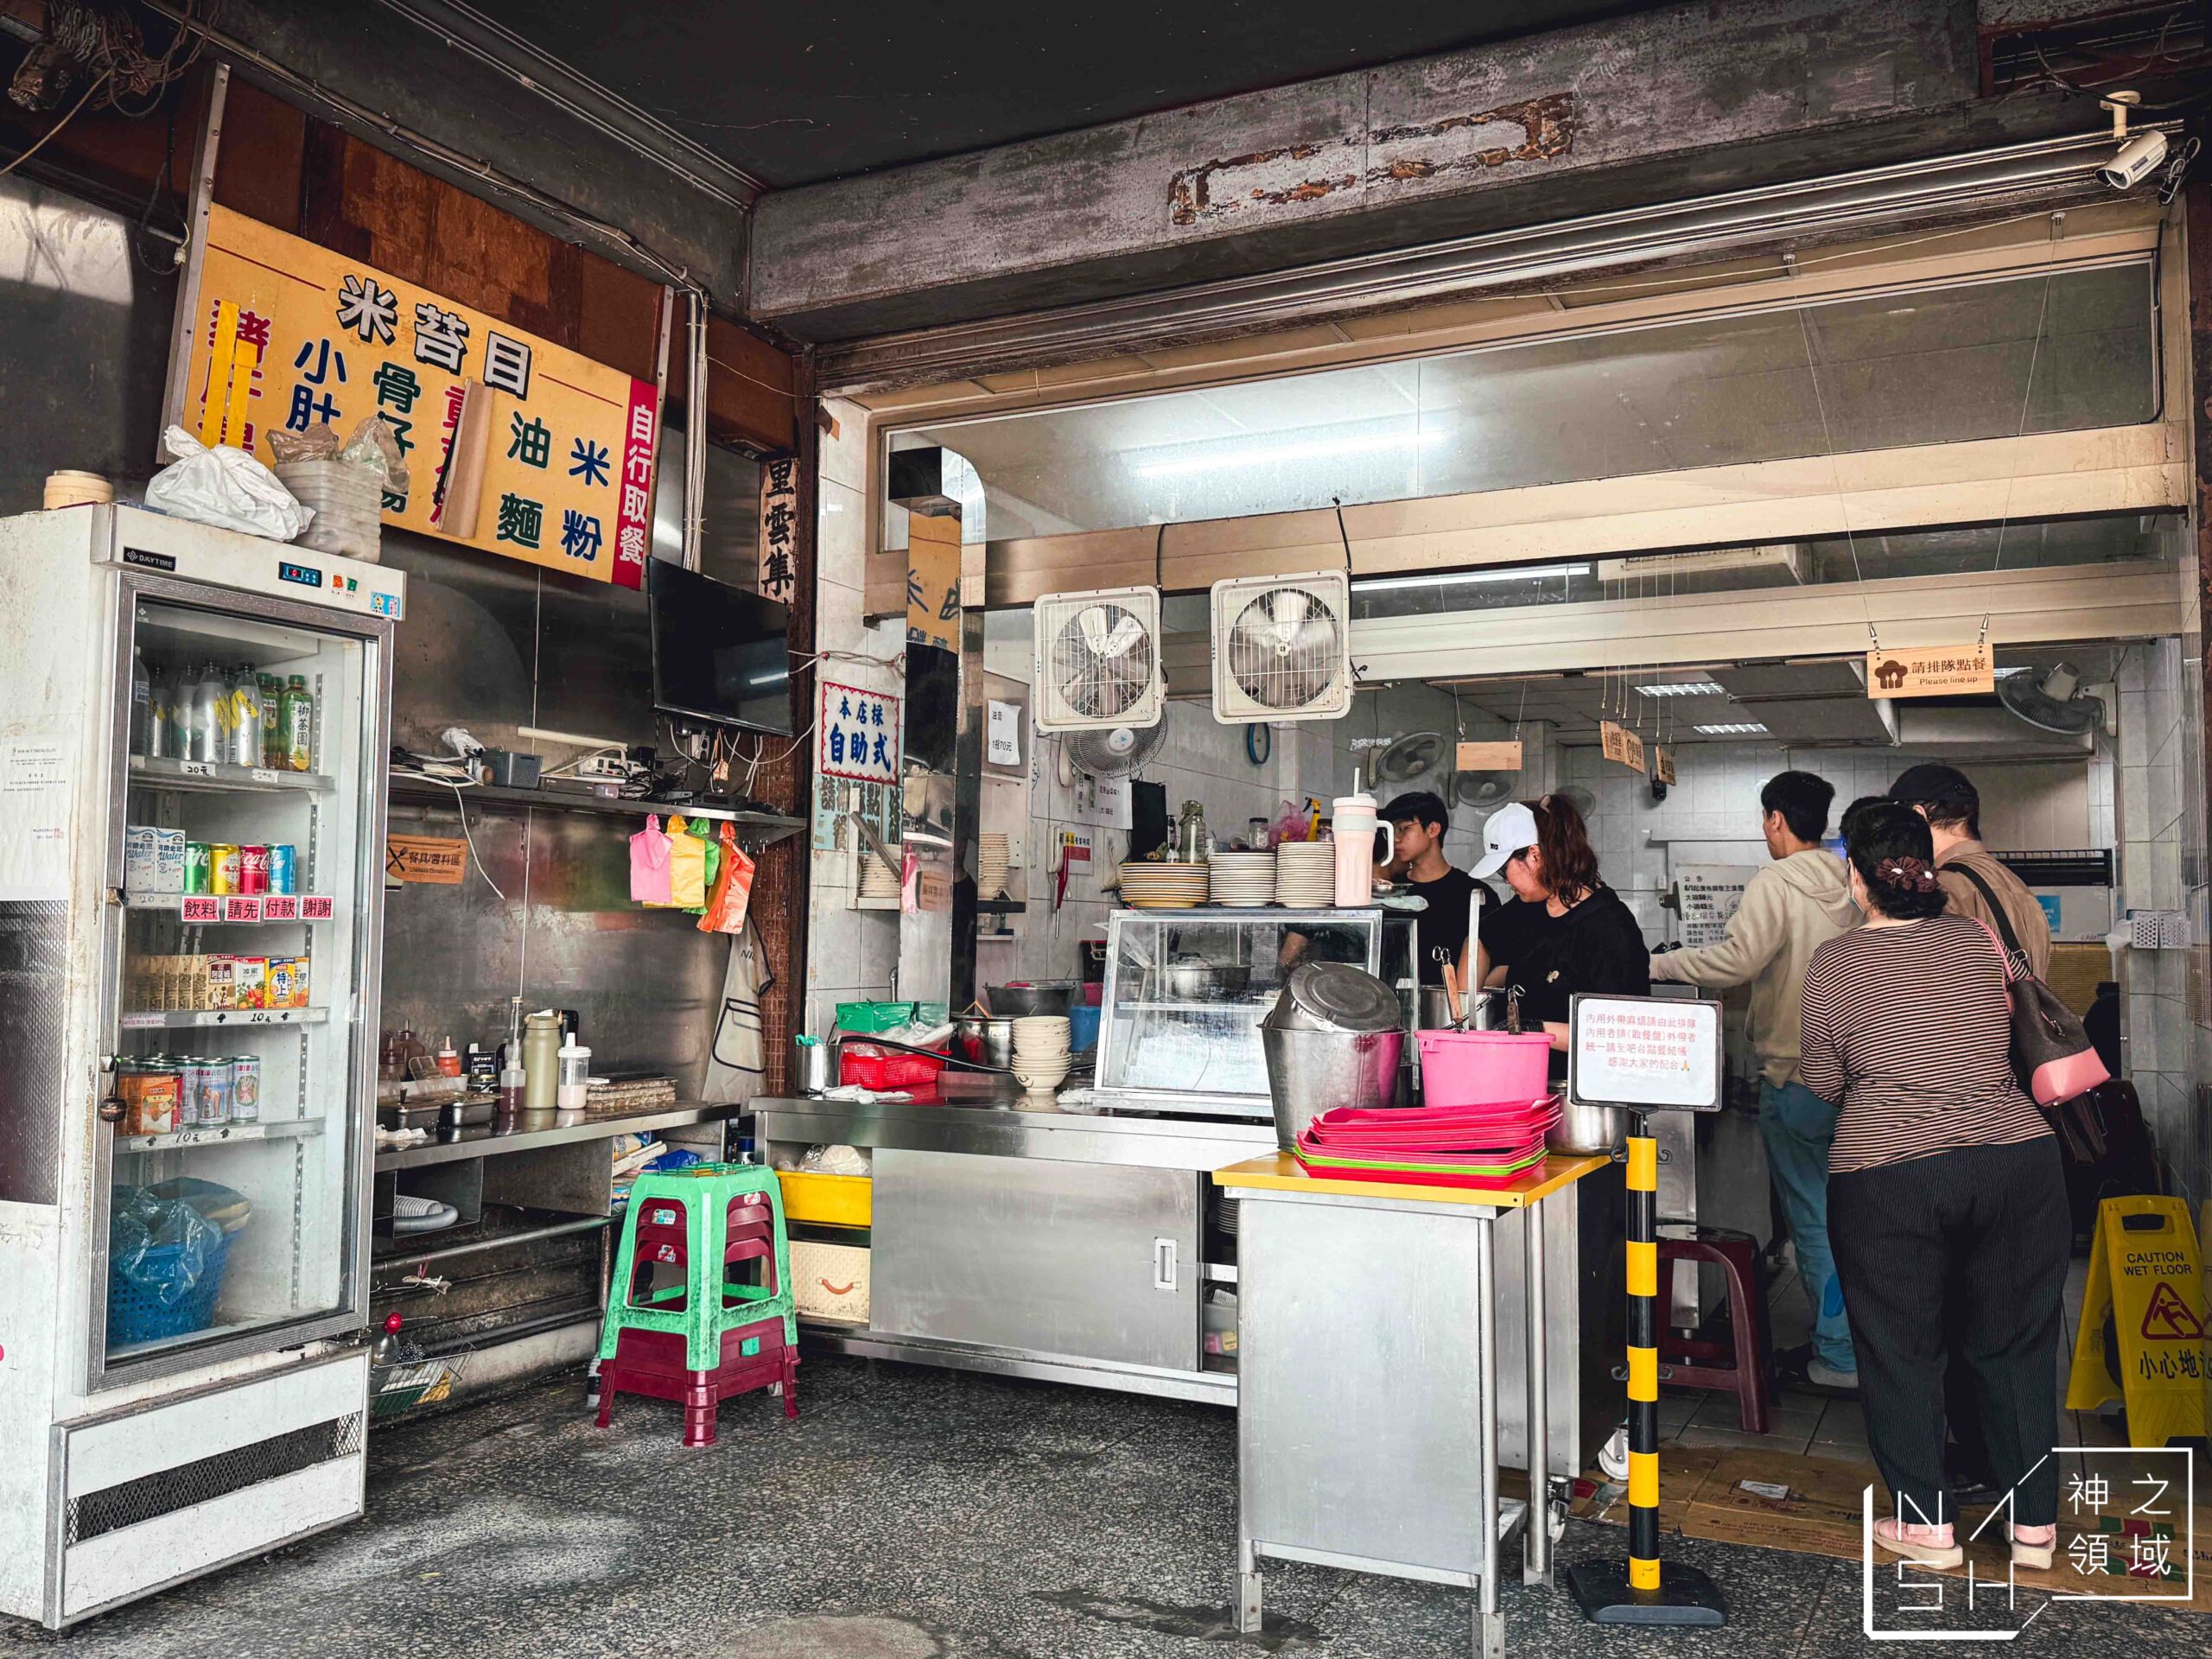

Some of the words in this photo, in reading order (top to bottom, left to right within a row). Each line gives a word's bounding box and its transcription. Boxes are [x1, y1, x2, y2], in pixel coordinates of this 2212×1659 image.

[338, 274, 532, 402] 米苔目
[496, 410, 551, 550] 油麵
[617, 404, 655, 567] 自行取餐
[560, 436, 610, 562] 米粉
[138, 554, 174, 569] DAYTIME
[1911, 657, 1986, 674] 請排隊點餐
[1967, 677, 1979, 685] up
[839, 696, 884, 727] 本店採
[297, 705, 310, 746] 御茶園
[830, 722, 892, 772] 自助式
[187, 766, 210, 776] 20元
[157, 850, 184, 861] Water
[183, 900, 218, 919] 飲料
[227, 899, 258, 918] 請先
[265, 899, 295, 917] 付款
[302, 899, 332, 917] 謝謝
[276, 973, 288, 995] 特上
[175, 1133, 200, 1144] 10元
[2126, 1251, 2185, 1263] CAUTION
[2124, 1266, 2148, 1276] WET
[2154, 1264, 2193, 1275] FLOOR
